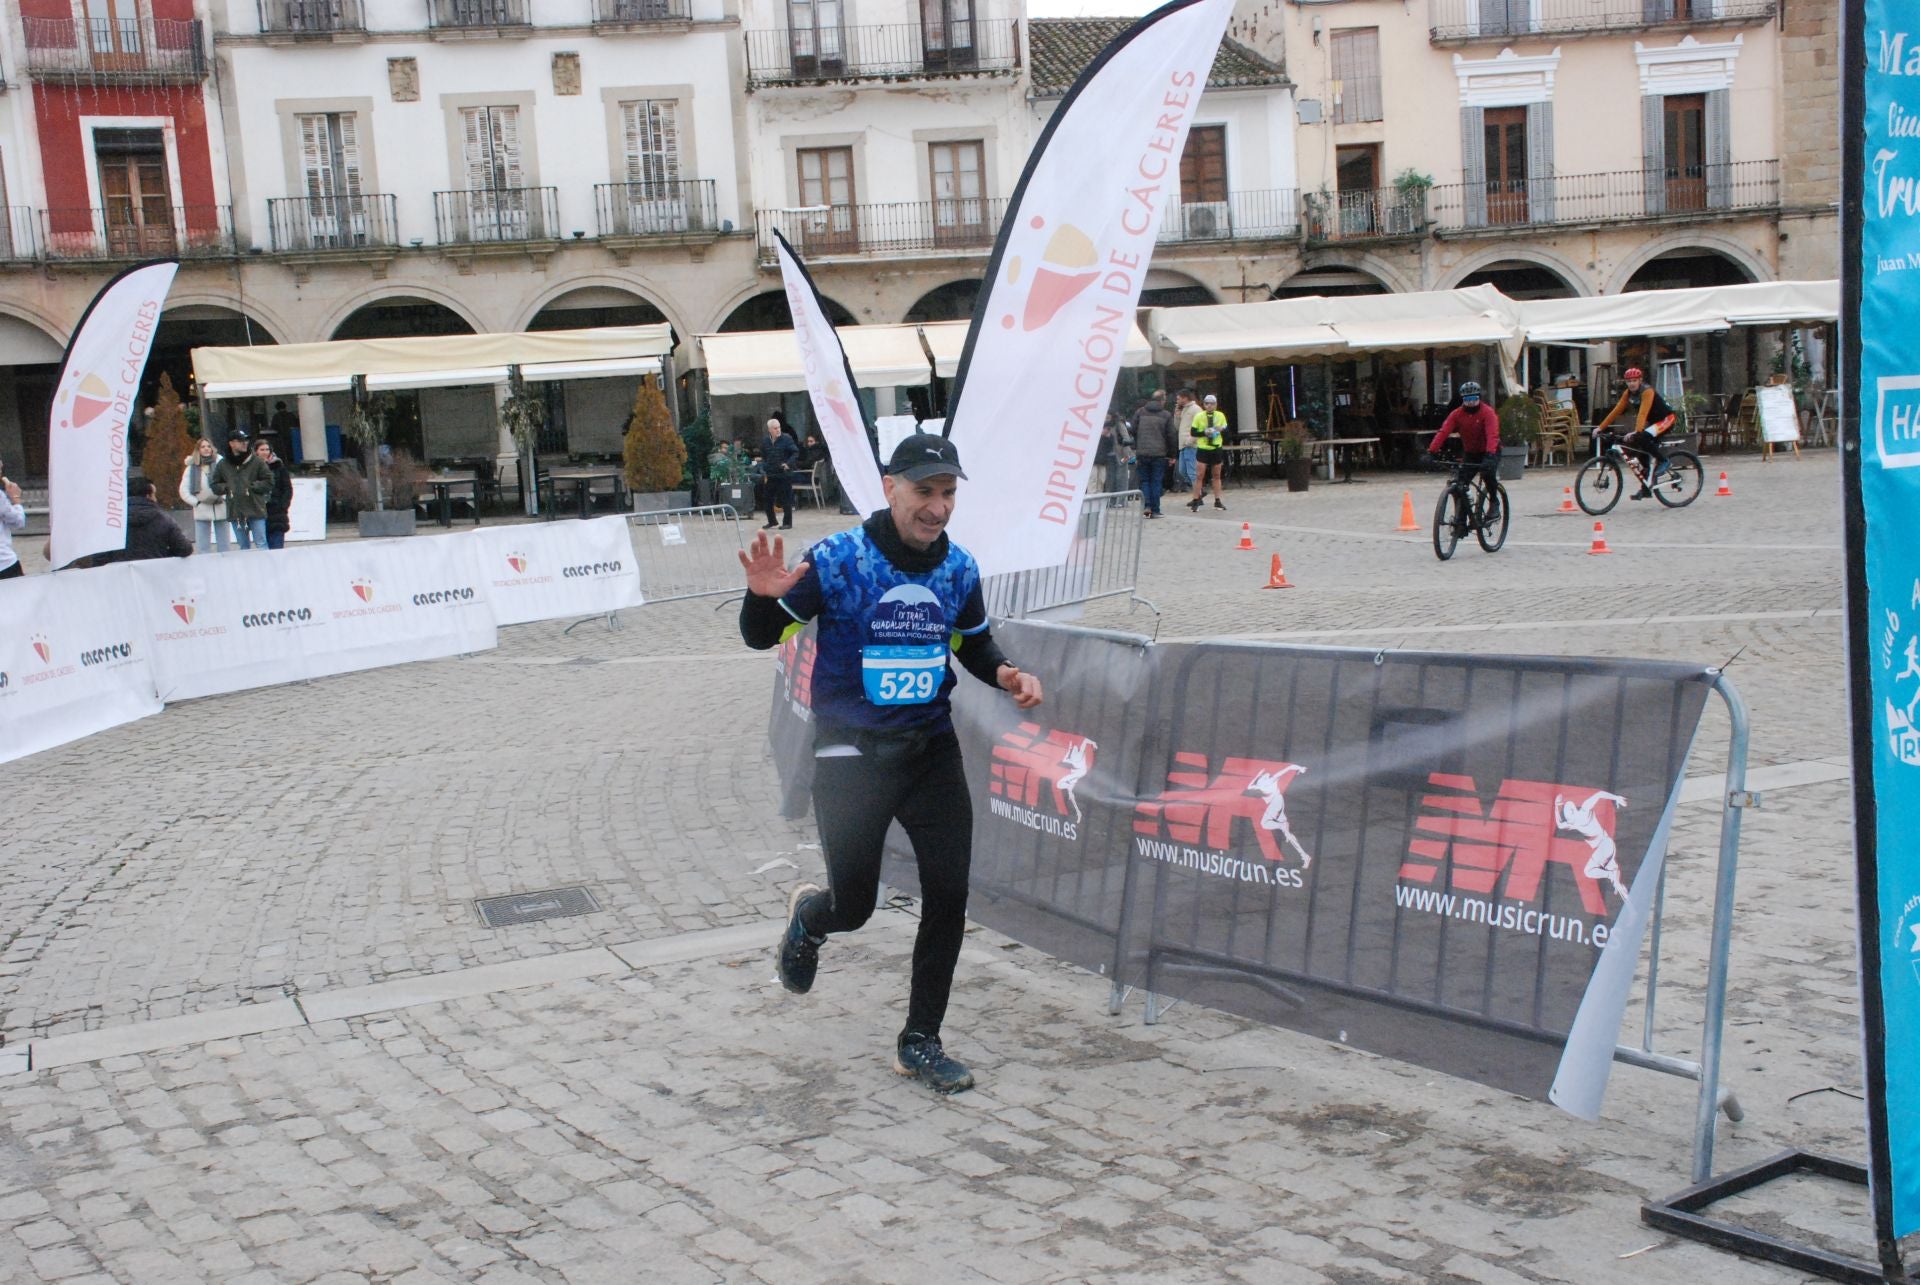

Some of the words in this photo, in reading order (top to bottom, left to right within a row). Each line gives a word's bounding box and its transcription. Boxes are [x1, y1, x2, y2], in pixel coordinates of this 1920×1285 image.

[1876, 254, 1906, 276] Juan
[1039, 304, 1124, 526] DIPUTACIÓN
[1102, 247, 1140, 295] DE
[1121, 70, 1196, 236] CÁCERES
[120, 299, 158, 385] CÁCERES
[113, 390, 131, 416] DE
[106, 420, 125, 529] DIPUTACIÓN
[871, 620, 910, 631] GUADALUPE
[906, 611, 926, 621] TRAIL
[879, 671, 934, 700] 529
[990, 796, 1078, 842] www.musicrun.es
[1136, 836, 1304, 889] www.musicrun.es
